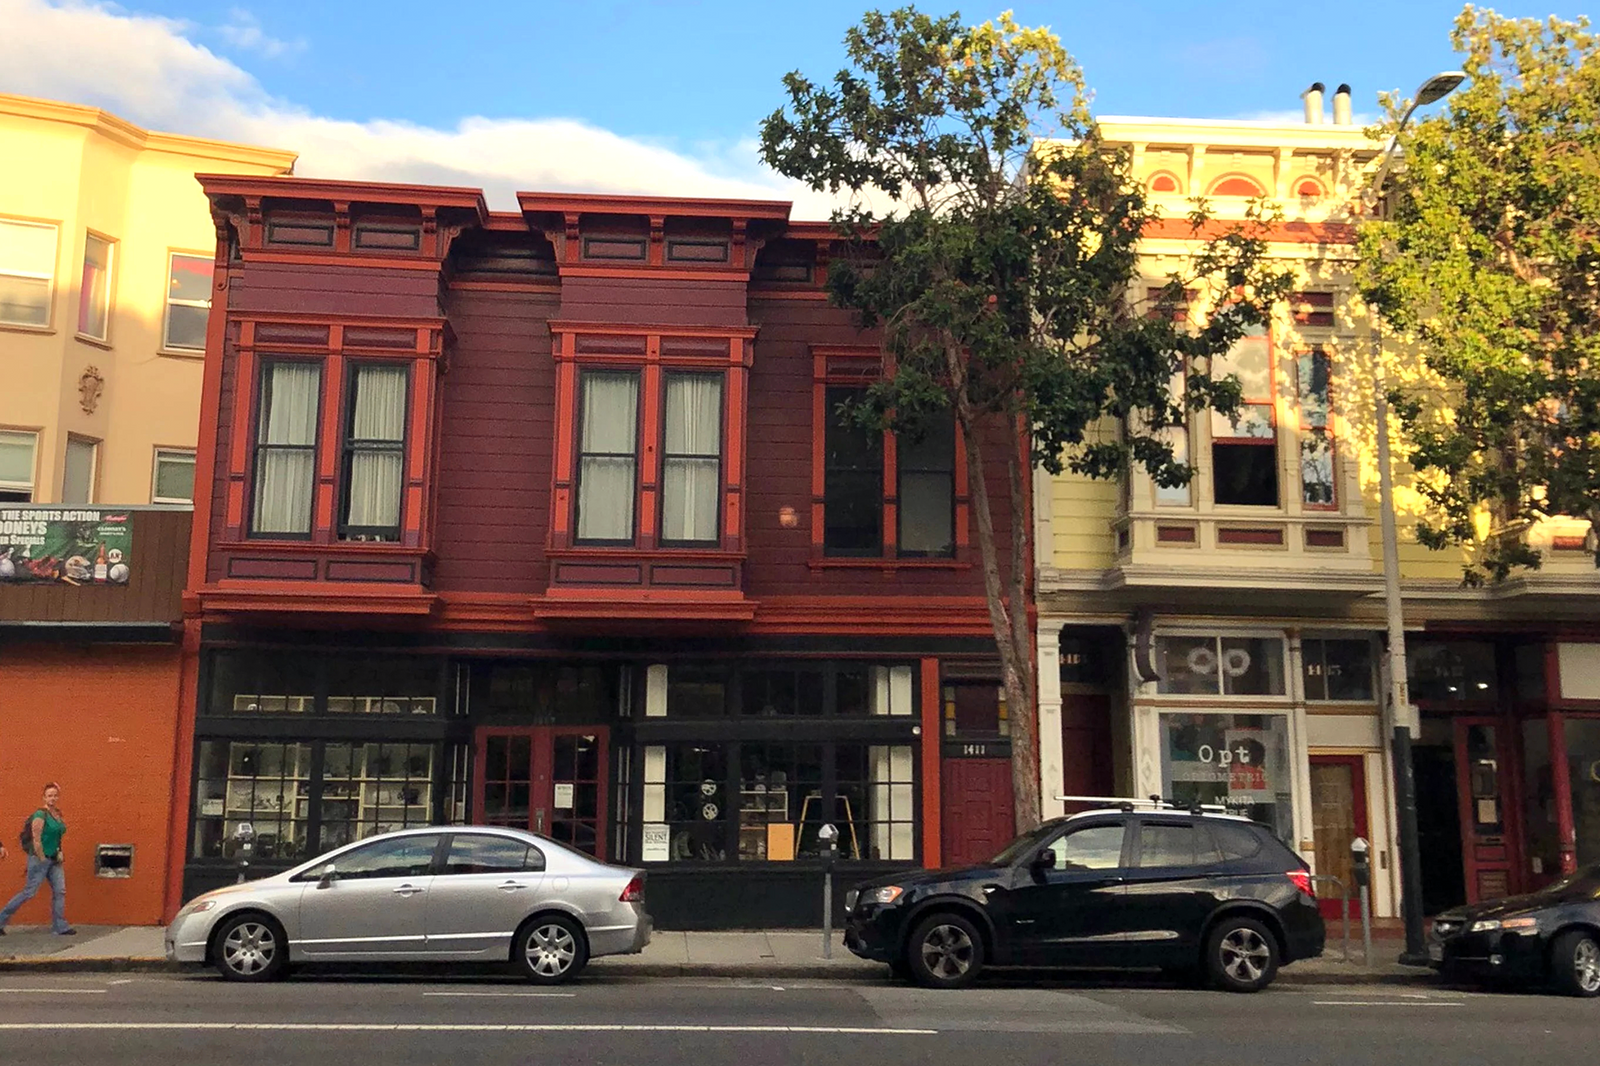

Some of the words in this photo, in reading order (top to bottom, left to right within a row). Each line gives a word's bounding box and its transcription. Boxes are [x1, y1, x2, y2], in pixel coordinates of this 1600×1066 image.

[2, 511, 20, 520] THE
[22, 511, 61, 521] SPORTS
[62, 511, 100, 521] ACTION
[963, 744, 985, 755] 1411
[1199, 745, 1250, 768] Opt
